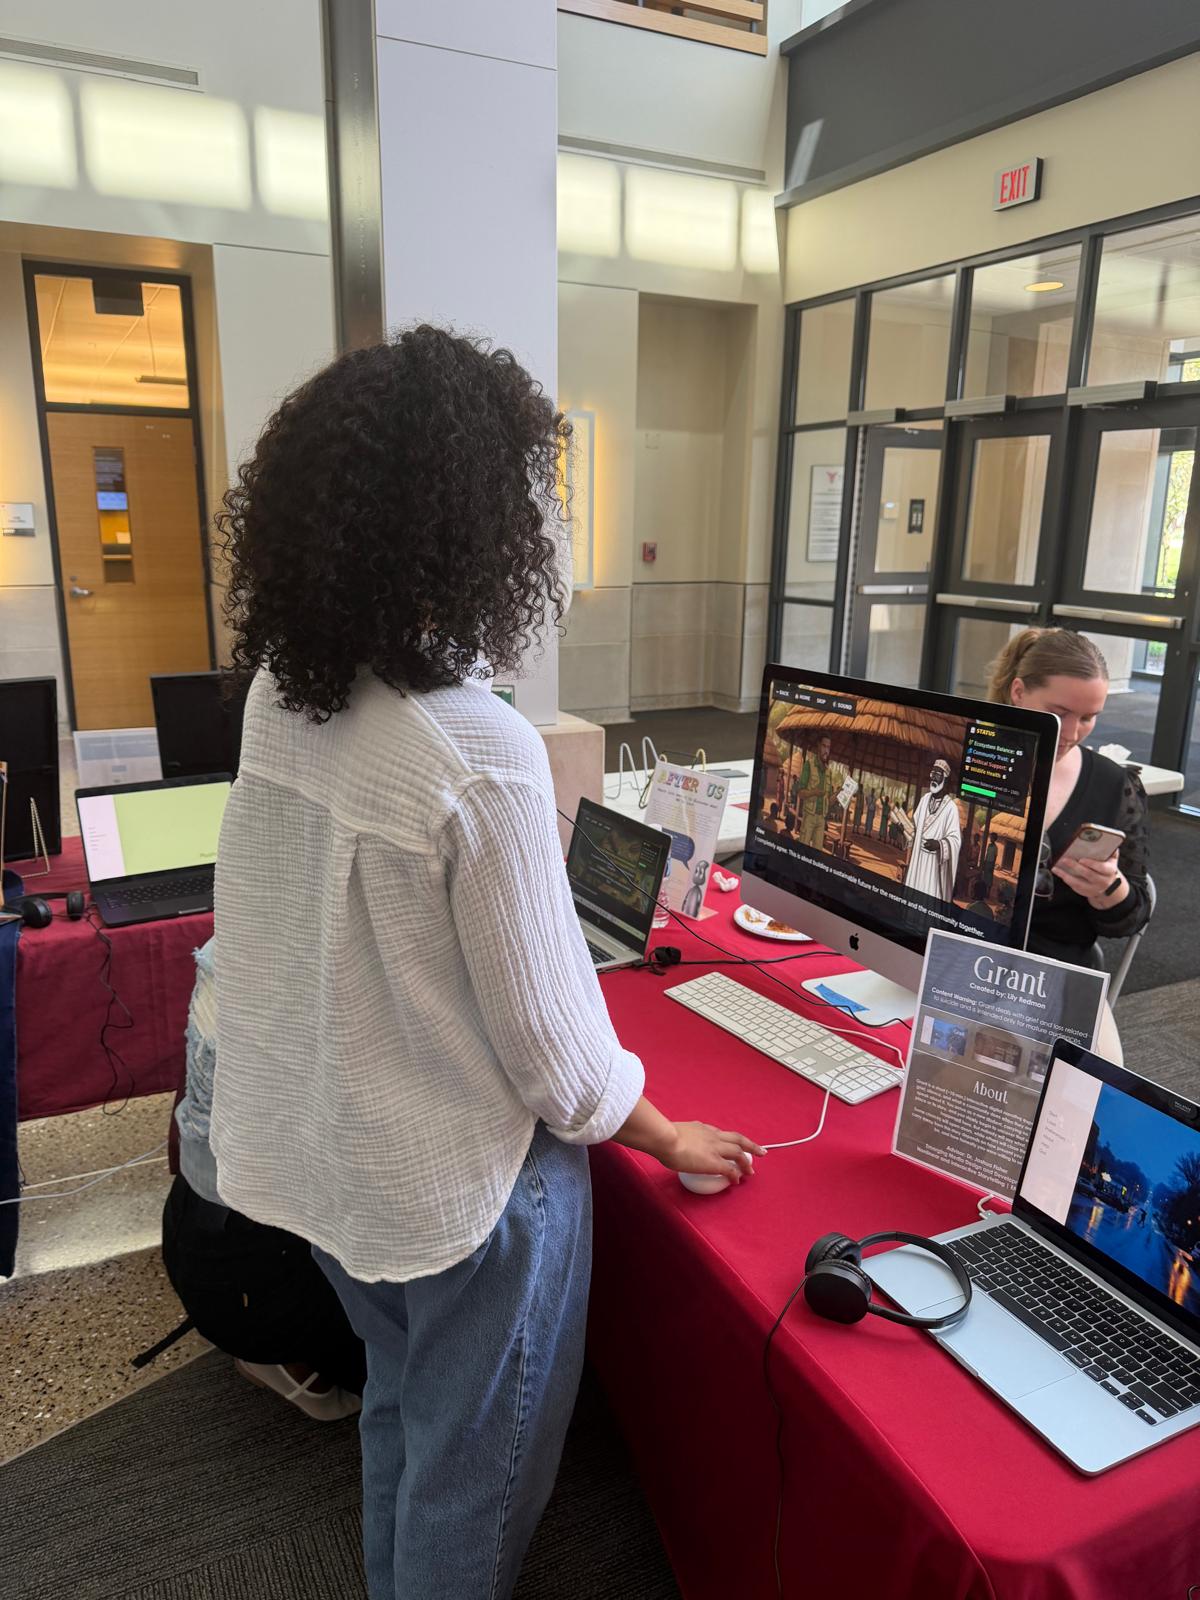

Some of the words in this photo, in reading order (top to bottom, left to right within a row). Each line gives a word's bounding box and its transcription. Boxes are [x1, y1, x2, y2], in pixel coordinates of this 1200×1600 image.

[1000, 165, 1030, 204] EXIT
[976, 728, 996, 737] STATUS
[973, 749, 996, 759] Community
[989, 762, 1007, 771] Support:
[706, 782, 725, 800] US
[757, 837, 776, 849] completely
[801, 855, 812, 864] about
[812, 860, 829, 872] building
[833, 869, 857, 884] sustainable
[858, 878, 871, 890] future
[880, 889, 888, 897] the
[888, 893, 907, 905] reserve
[907, 901, 918, 910] and
[918, 905, 927, 914] the
[928, 910, 958, 927] community
[959, 922, 985, 938] together.
[974, 955, 1047, 998] Grant
[970, 982, 995, 995] Created
[995, 987, 1006, 999] by:
[1007, 993, 1018, 1002] Lily
[1018, 996, 1046, 1009] Redmon
[931, 986, 952, 997] Content
[953, 993, 977, 1005] Warning:
[978, 1000, 994, 1010] Grant
[995, 1006, 1011, 1015] deals
[1025, 1015, 1039, 1024] grief
[1039, 1019, 1052, 1027] and
[1064, 1027, 1087, 1038] related
[976, 1008, 1002, 1020] intended
[1003, 1016, 1015, 1024] only
[1025, 1023, 1047, 1033] mature
[973, 1081, 1008, 1104] About
[974, 1156, 992, 1168] Joshua
[976, 1171, 1005, 1187] Storytelling
